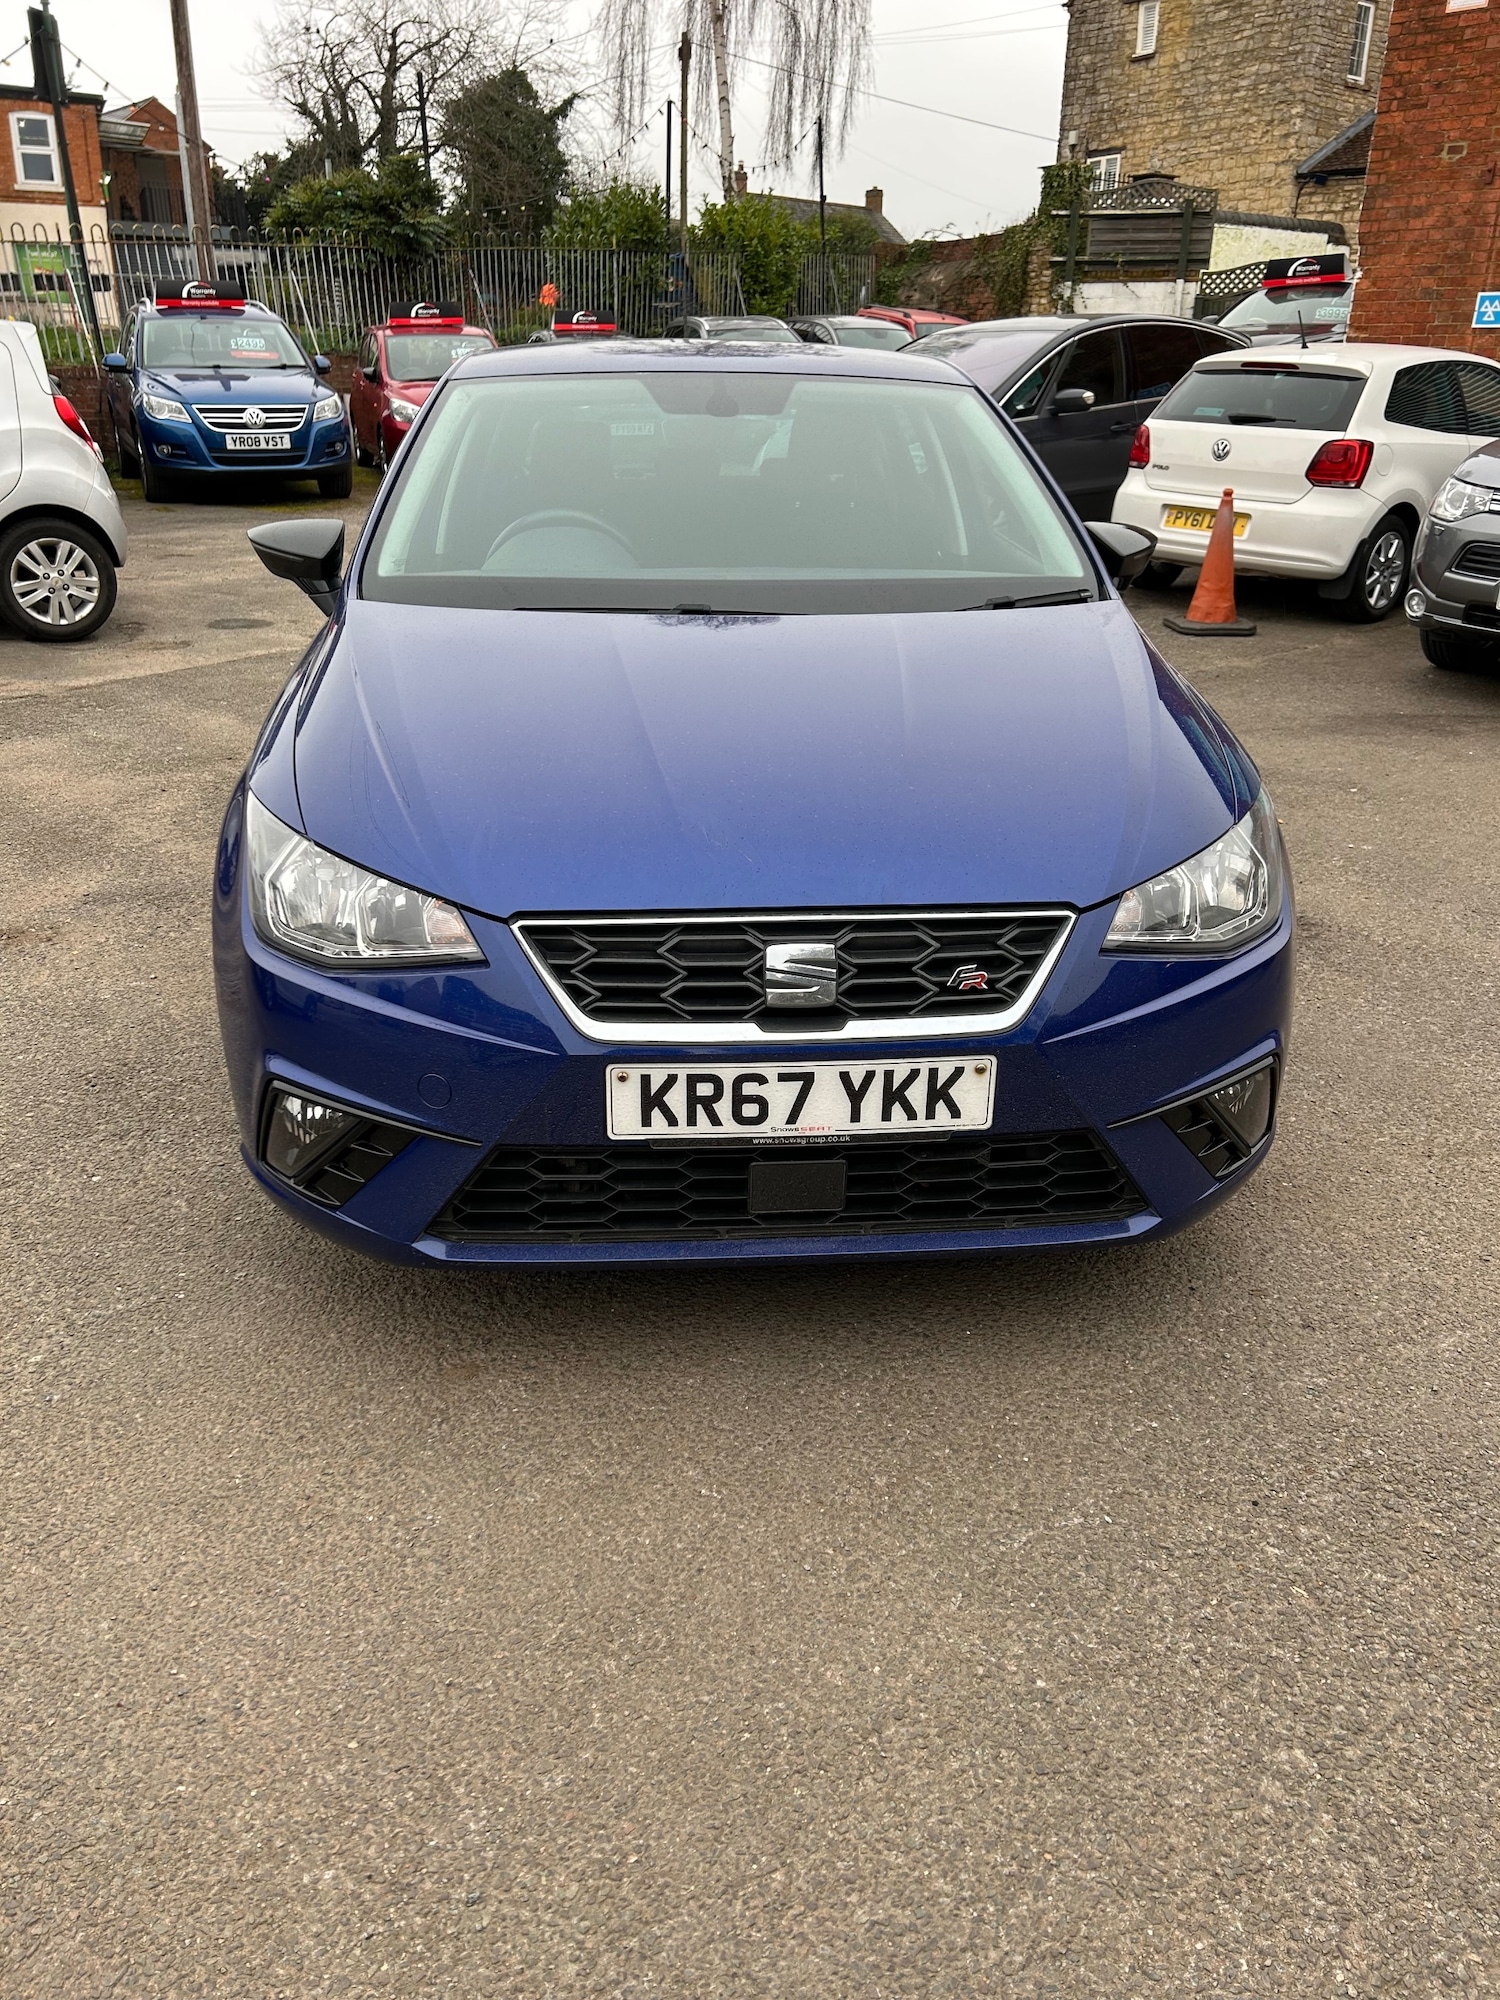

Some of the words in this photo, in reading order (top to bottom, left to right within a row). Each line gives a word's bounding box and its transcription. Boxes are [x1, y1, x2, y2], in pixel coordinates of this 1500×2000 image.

[190, 287, 216, 296] Warranty
[1315, 307, 1348, 320] £3995
[230, 338, 265, 350] £2495
[231, 436, 261, 448] YR08
[264, 436, 285, 447] VST
[1172, 511, 1206, 528] PY61
[947, 964, 988, 990] FR
[640, 1071, 816, 1127] KR67
[838, 1066, 966, 1122] YKK
[752, 1134, 851, 1145] www.snowsgroup.co.uk
